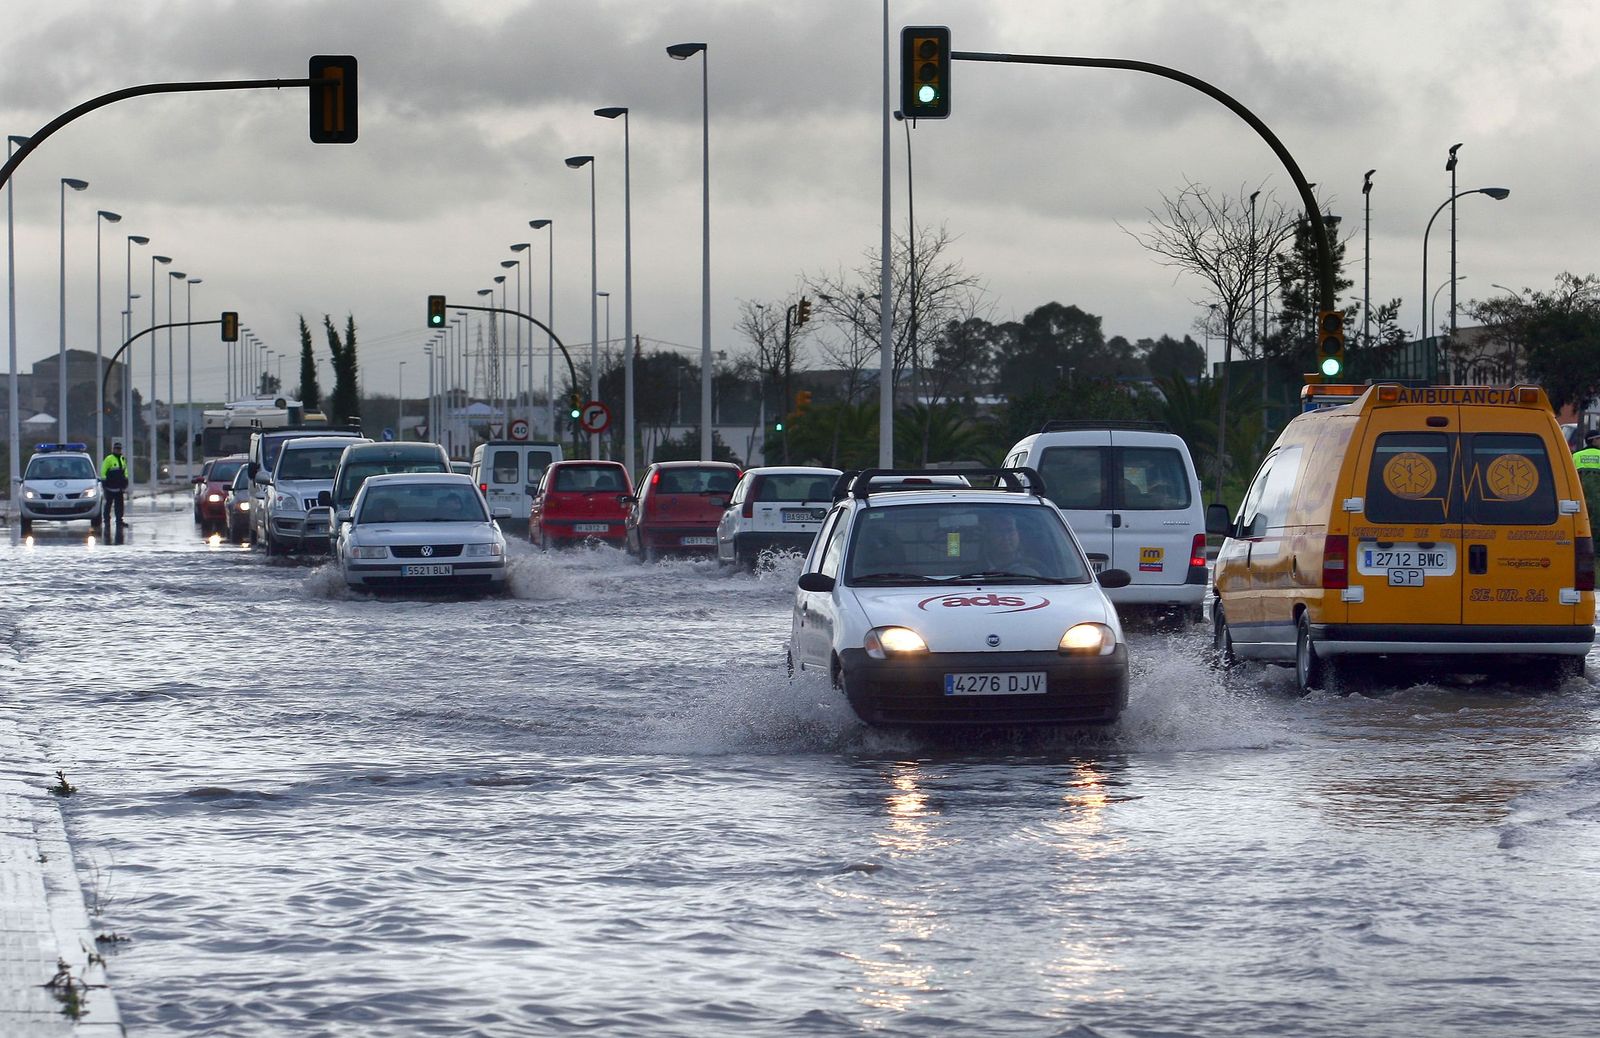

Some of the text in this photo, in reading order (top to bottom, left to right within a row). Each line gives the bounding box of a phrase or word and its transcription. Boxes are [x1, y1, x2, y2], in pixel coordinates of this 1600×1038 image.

[1398, 388, 1518, 404] AMBULANCIA
[514, 427, 527, 435] 40
[1376, 553, 1444, 567] 2712 BWC
[408, 565, 450, 575] 5521 BLN
[942, 594, 1026, 607] ads
[955, 675, 1041, 692] 4276 DJV
